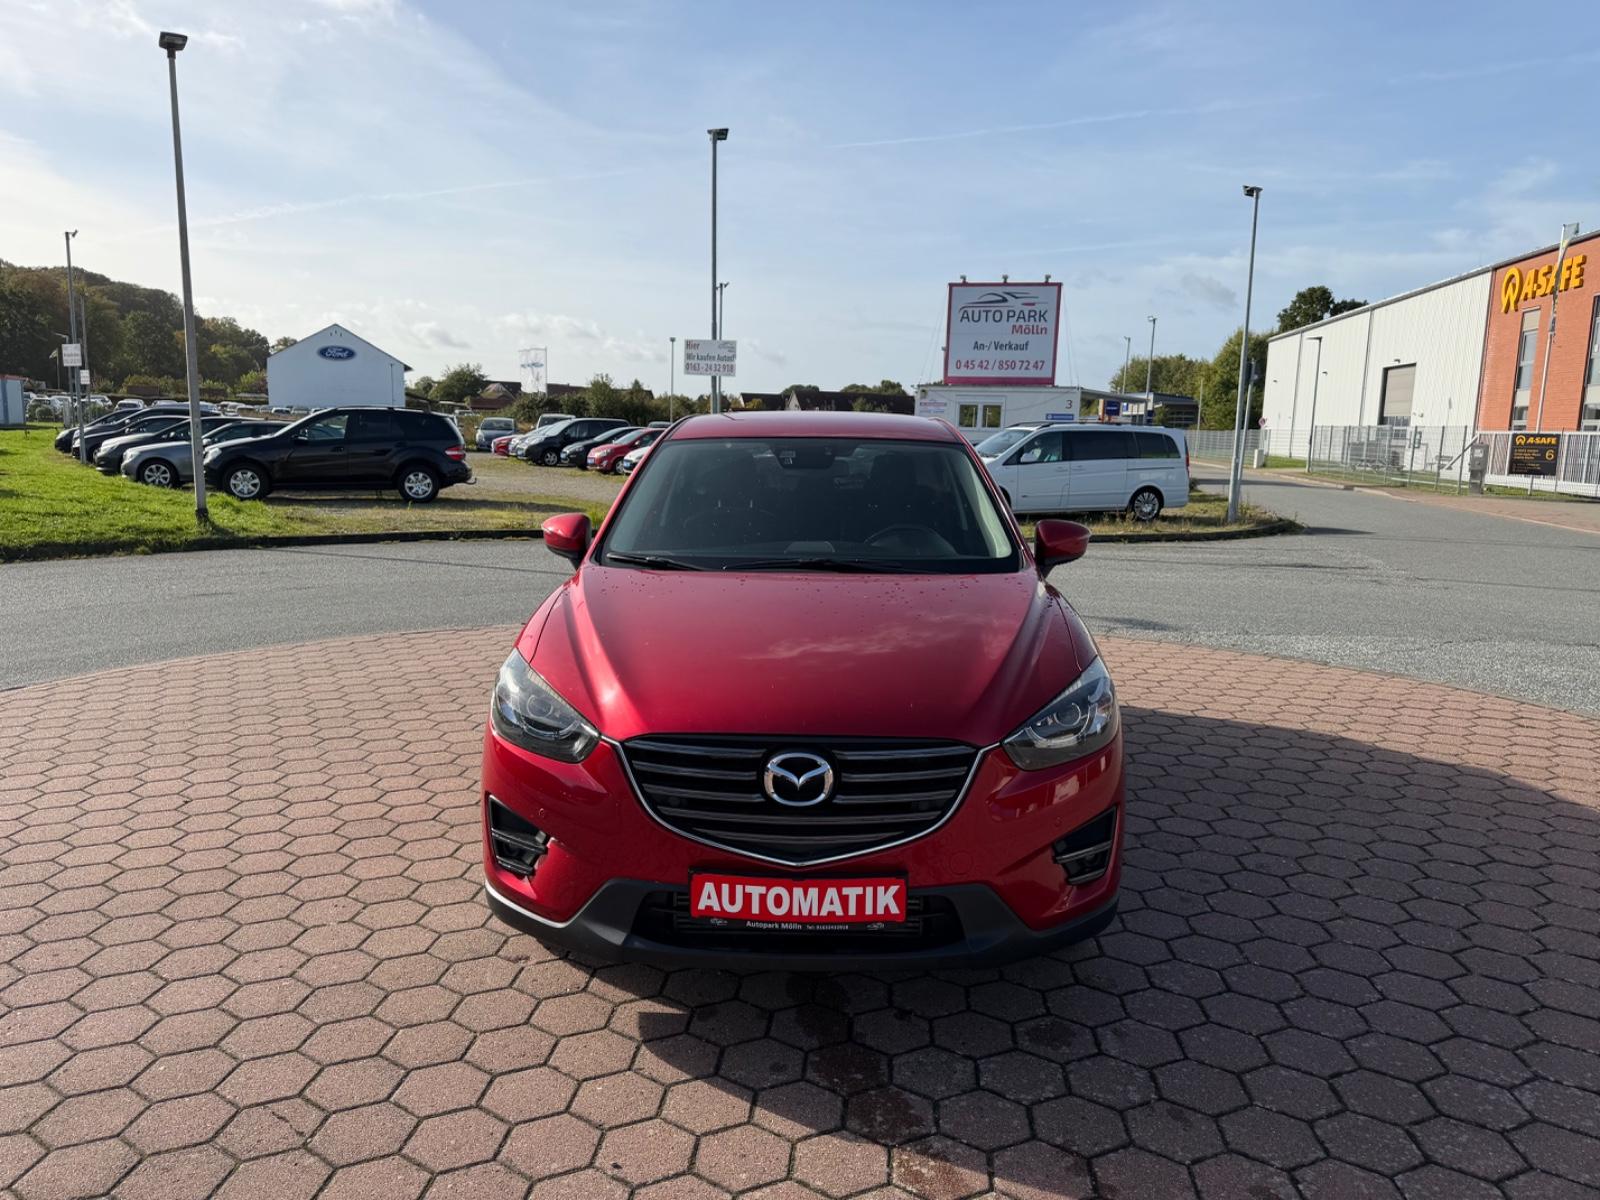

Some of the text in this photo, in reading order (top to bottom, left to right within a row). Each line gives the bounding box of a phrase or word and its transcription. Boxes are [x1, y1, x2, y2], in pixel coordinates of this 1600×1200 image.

[960, 309, 1048, 323] AUTO PARK
[1011, 324, 1048, 335] Mölln
[686, 340, 700, 350] Hier
[993, 340, 1030, 351] Verkauf
[325, 348, 349, 358] Ford
[686, 353, 696, 361] Wir
[697, 353, 717, 361] kaufen
[955, 360, 962, 370] 0
[963, 360, 975, 370] 45
[978, 360, 989, 370] 42
[998, 360, 1016, 370] 850
[1018, 360, 1031, 370] 72
[1033, 360, 1045, 370] 47
[1065, 400, 1073, 409] 3
[1545, 449, 1555, 460] 6
[697, 882, 900, 917] AUTOMATIK
[746, 921, 779, 929] Autopark
[781, 922, 802, 930] Mölln
